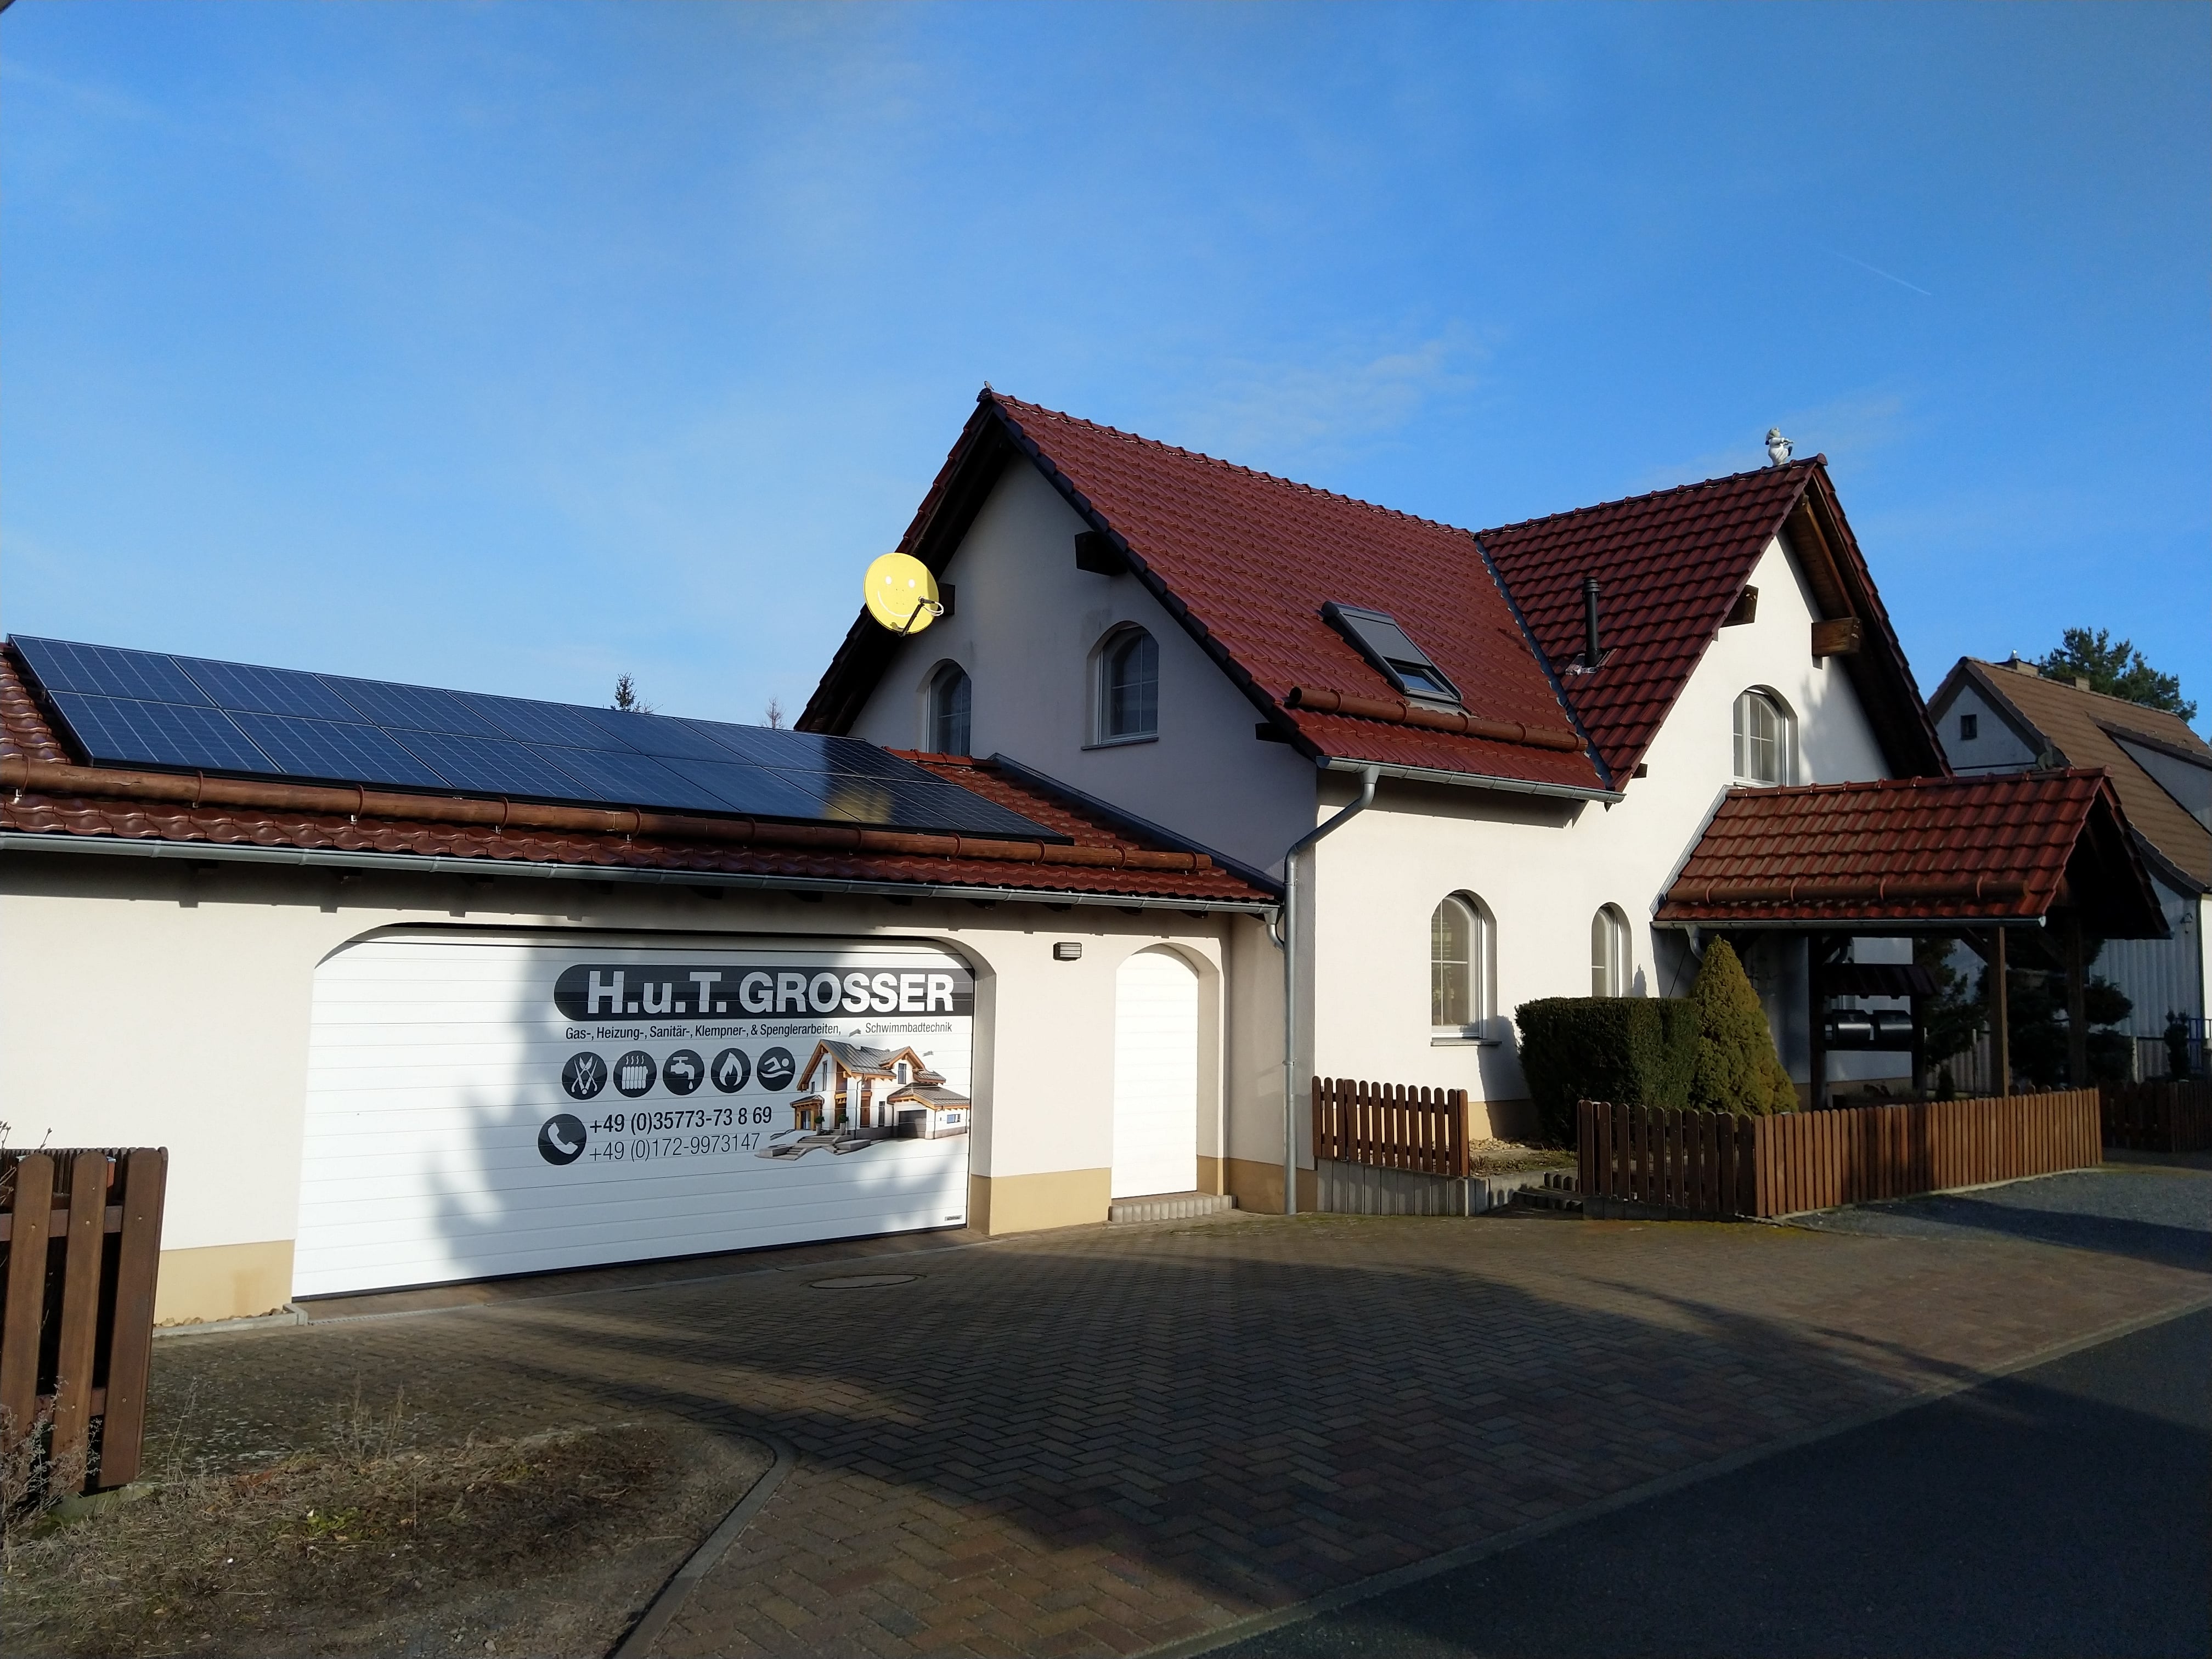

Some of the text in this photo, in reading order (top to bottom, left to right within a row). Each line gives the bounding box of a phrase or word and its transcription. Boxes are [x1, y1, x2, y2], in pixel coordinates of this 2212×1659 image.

[588, 970, 954, 1014] H.u.T. GROSSER
[566, 1022, 952, 1041] Gas-, Heizung-, Sanitär-, Klempner-, & Spenglerarbeiten, Schwimmbadtechnik
[590, 1107, 772, 1135] +49 (0)35773-73 8 69
[589, 1132, 760, 1162] +49 (0)172-9973147
